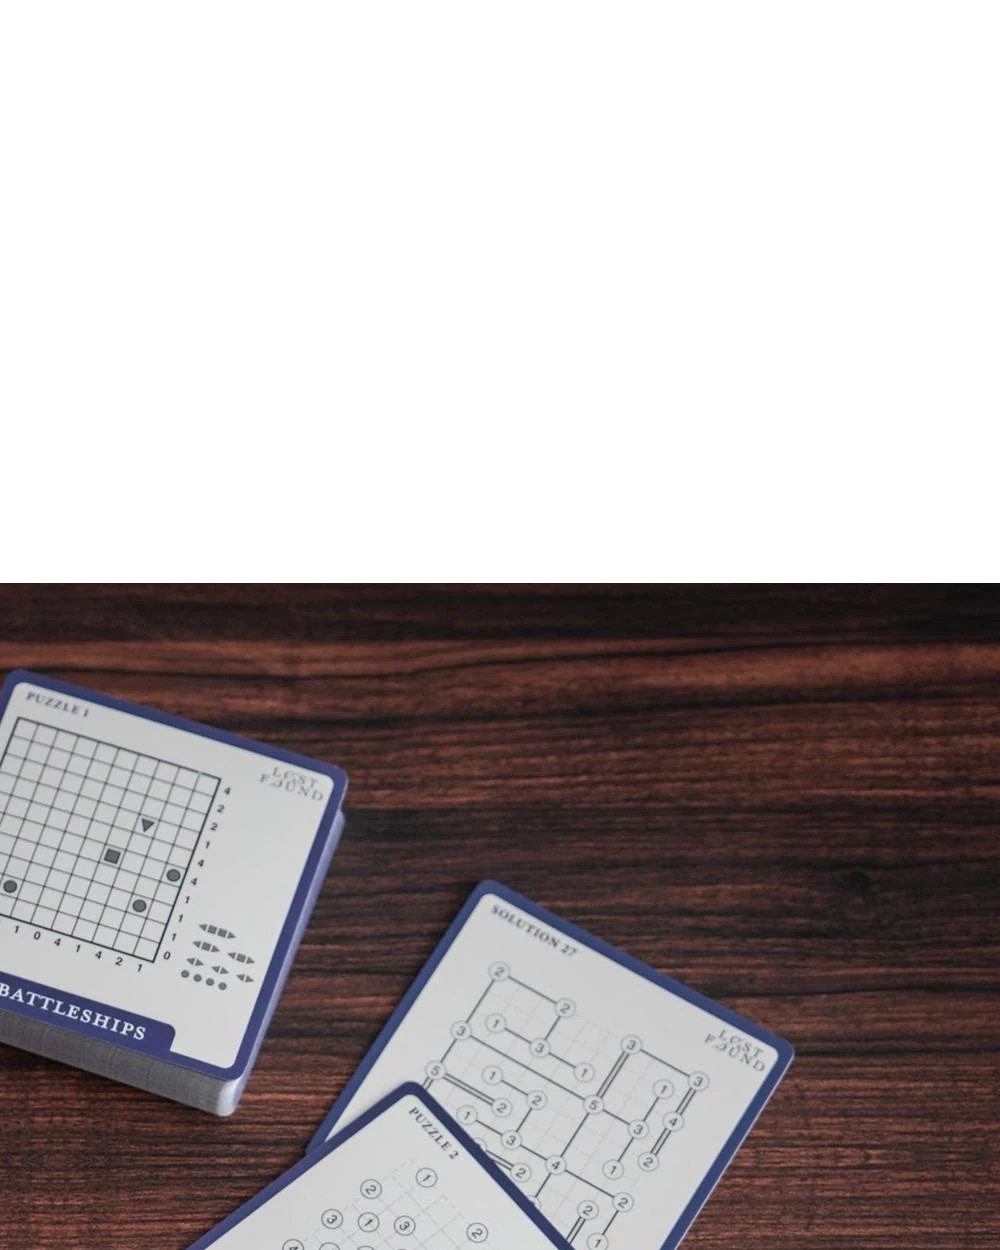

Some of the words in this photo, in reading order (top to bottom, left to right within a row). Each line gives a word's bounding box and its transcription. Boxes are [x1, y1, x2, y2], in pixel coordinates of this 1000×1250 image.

[26, 691, 81, 714] PUZZLE
[491, 904, 560, 948] SOLUTION
[561, 943, 577, 957] 27
[409, 1107, 451, 1151] PUZZLE
